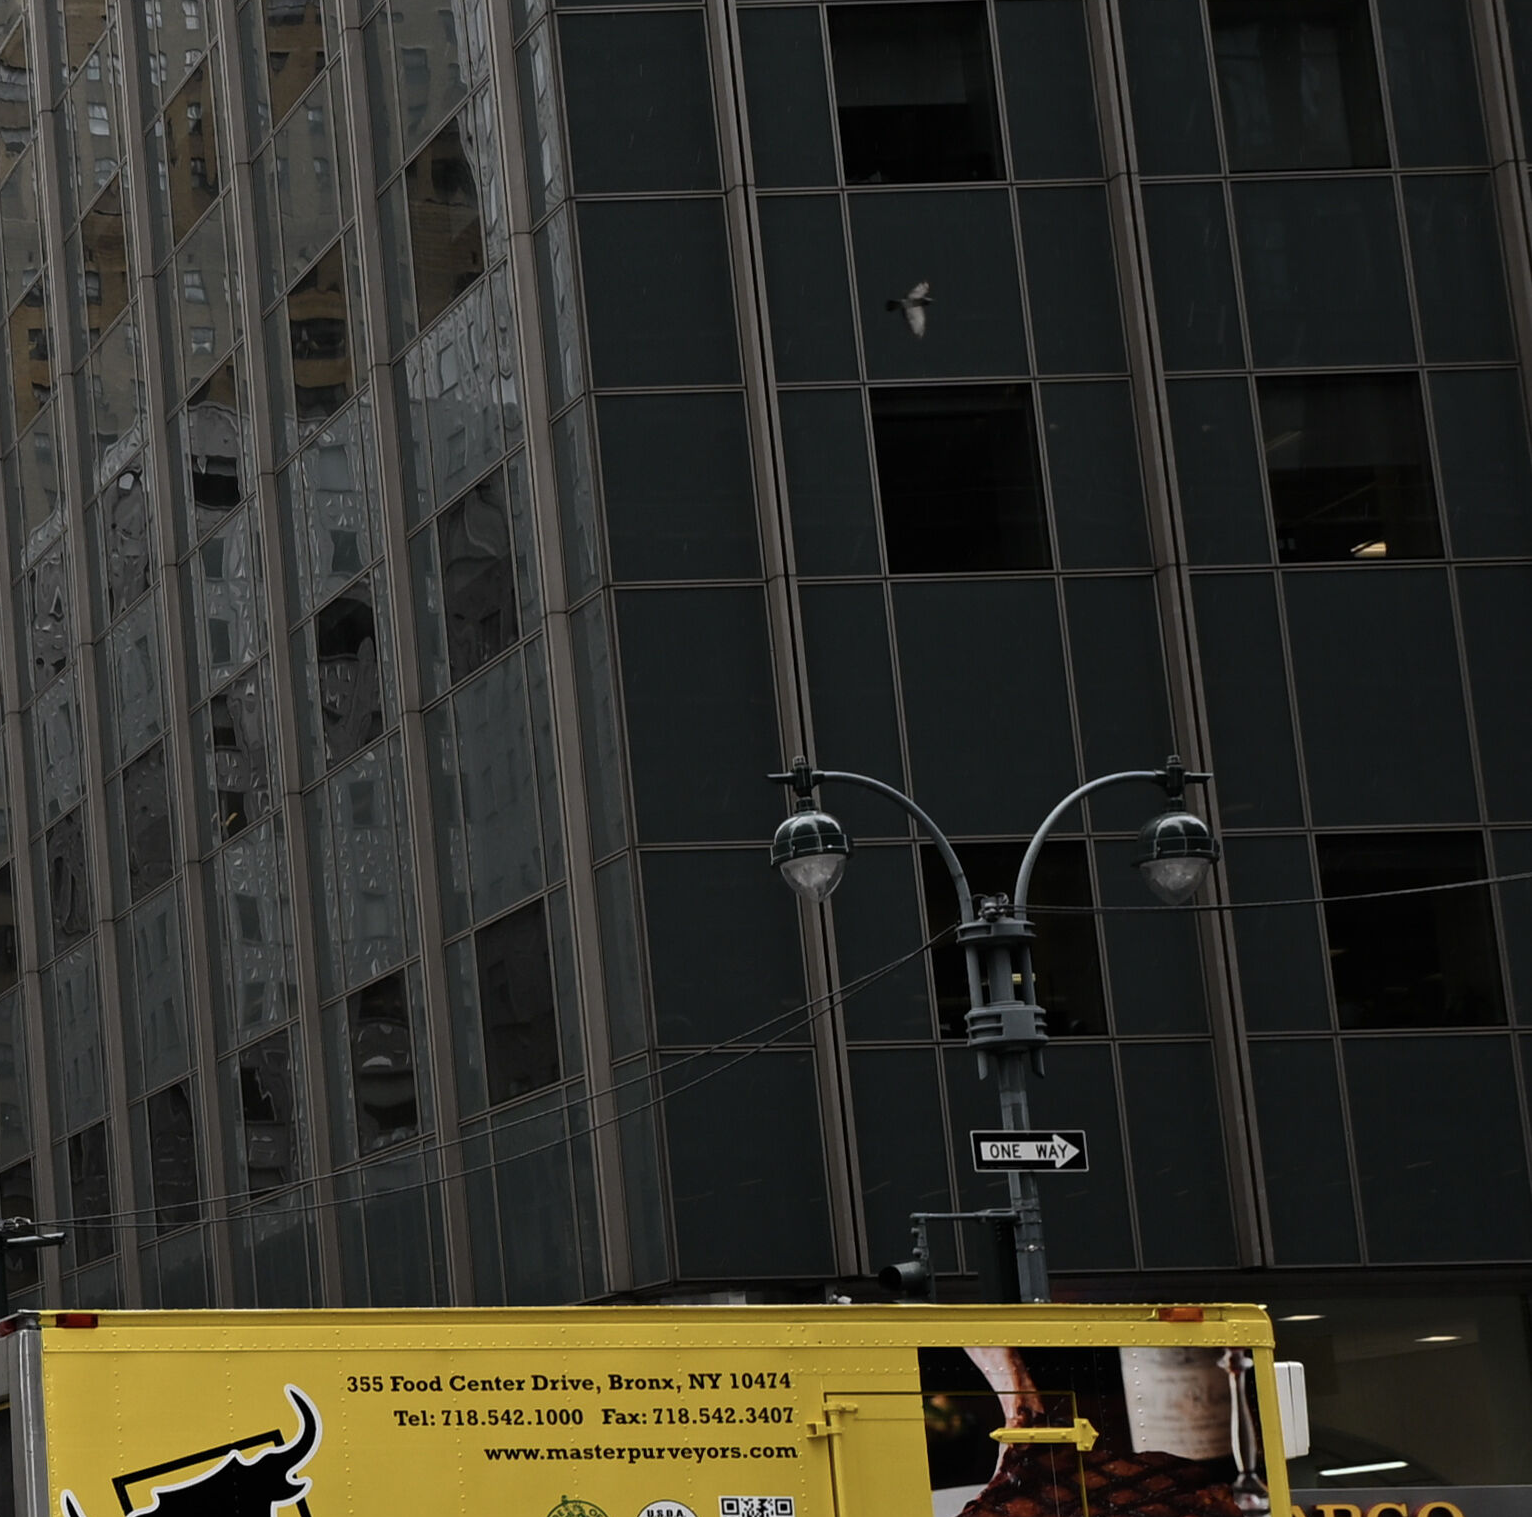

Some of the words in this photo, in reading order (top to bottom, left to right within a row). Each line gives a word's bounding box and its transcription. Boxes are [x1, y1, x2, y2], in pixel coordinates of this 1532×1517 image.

[989, 1143, 1022, 1159] ONE
[1035, 1143, 1068, 1159] WAY
[346, 1376, 384, 1393] 355
[390, 1376, 443, 1393] Food
[449, 1375, 525, 1393] Center
[531, 1374, 602, 1395] Drive,
[608, 1374, 681, 1394] Bronx,
[688, 1373, 722, 1391] NY
[729, 1372, 791, 1390] 10474
[393, 1410, 436, 1427] Tel:
[441, 1409, 584, 1427] 718.542.1000
[601, 1409, 648, 1426] Fax:
[653, 1407, 795, 1425] 718.542.3407
[484, 1443, 798, 1464] www.masterpurveyors.com
